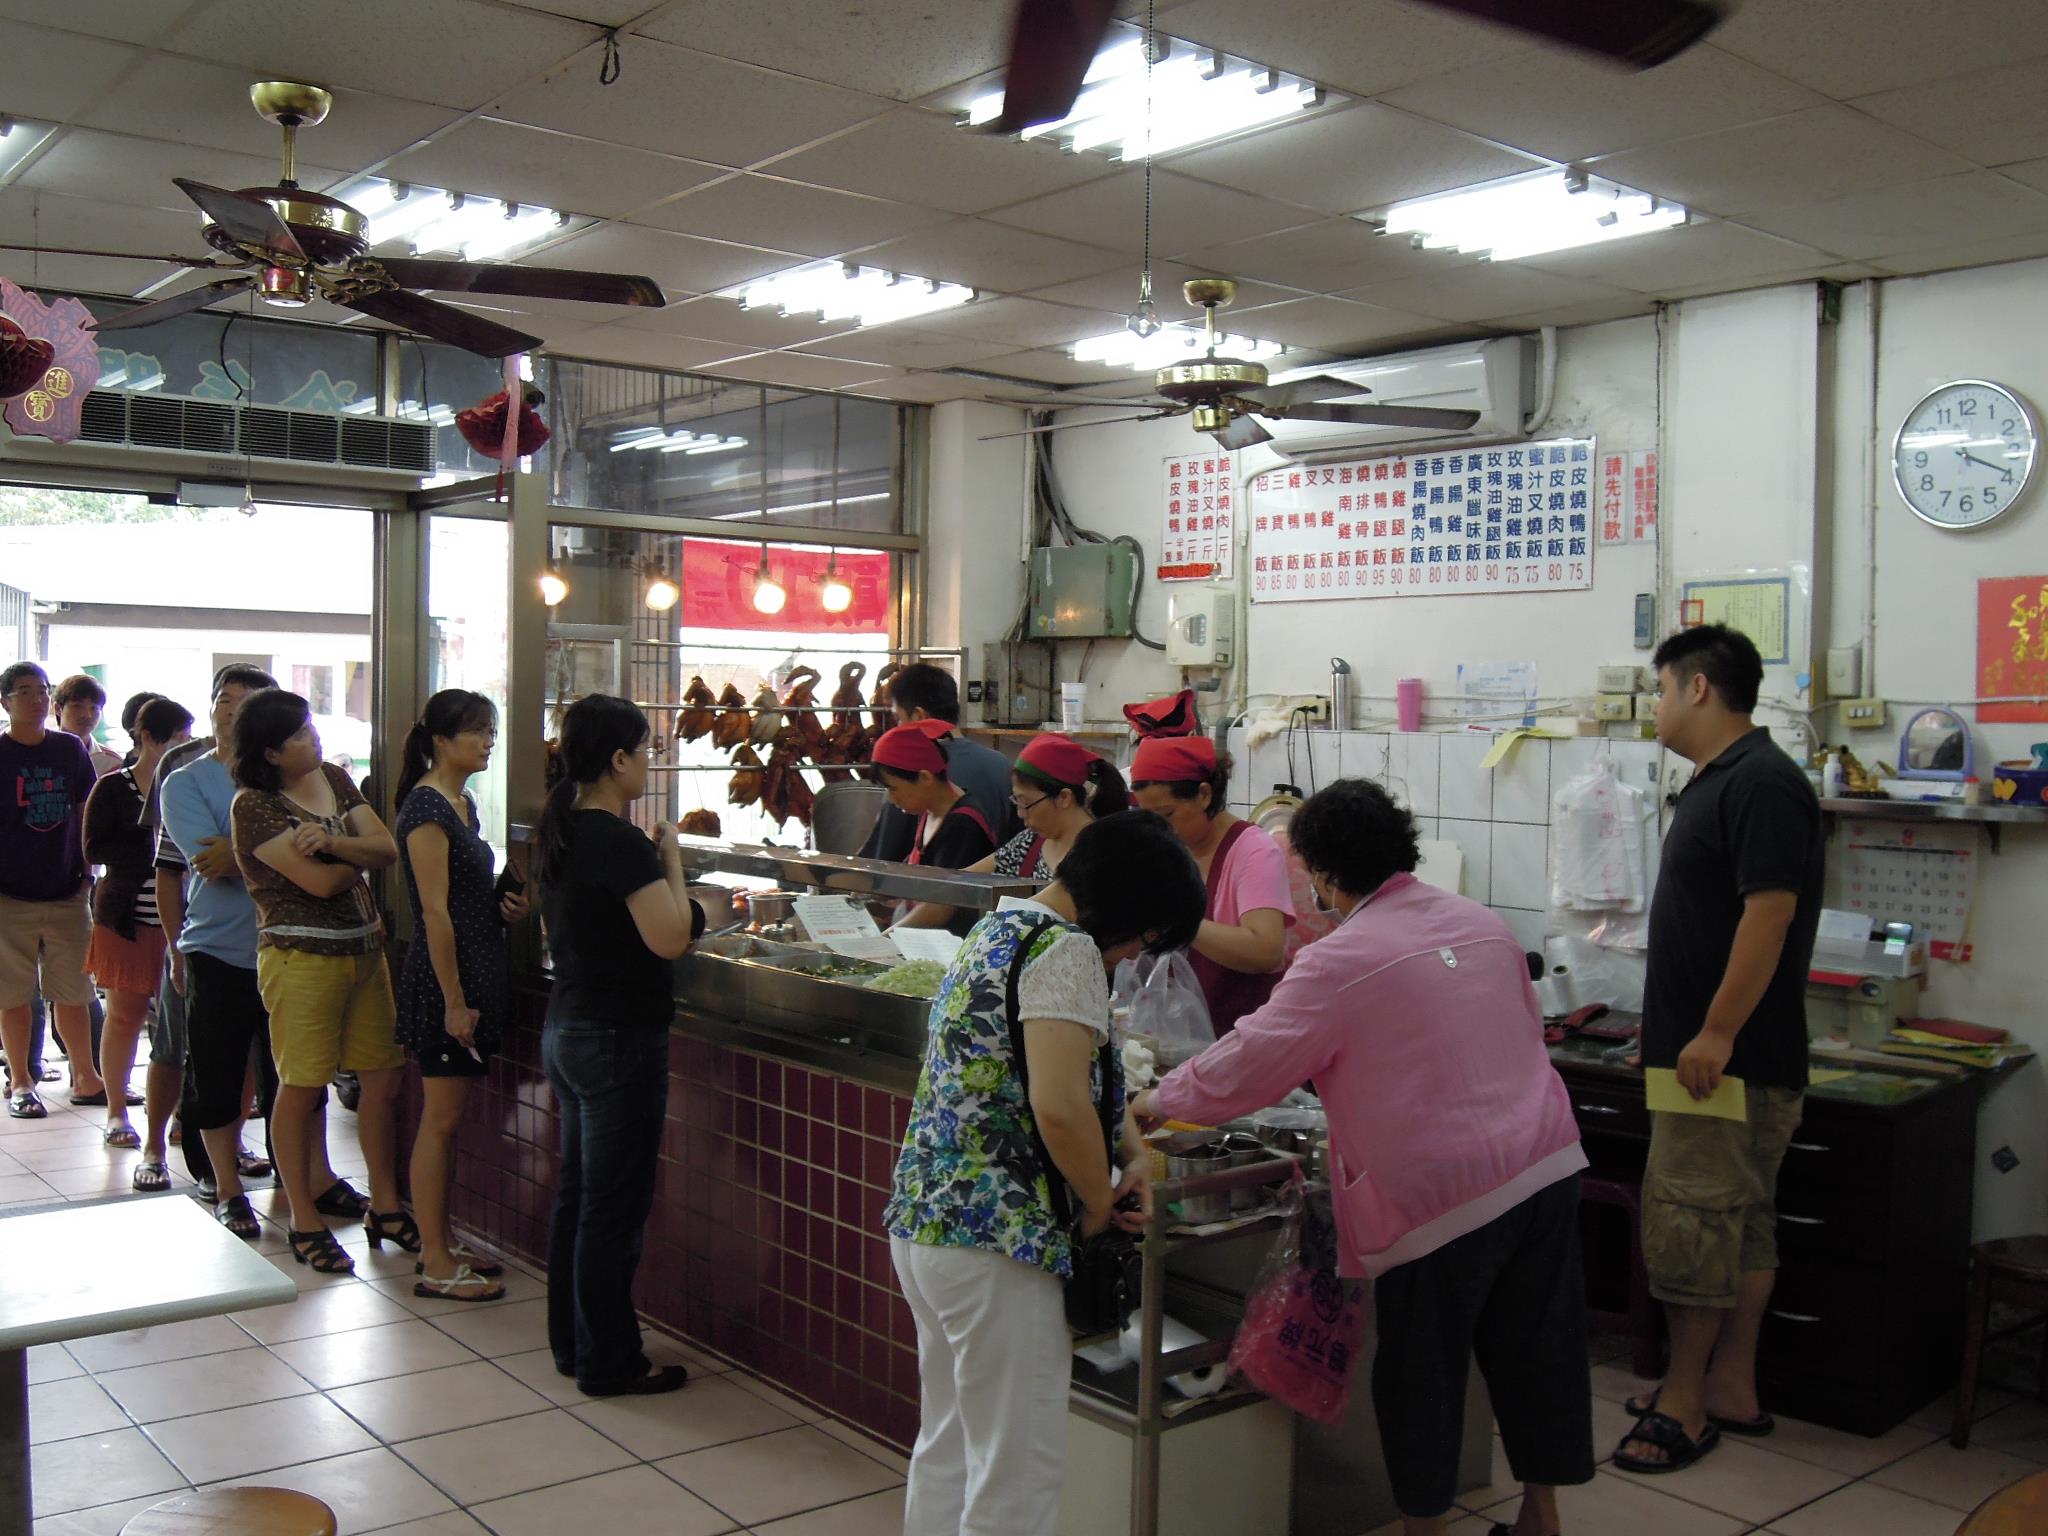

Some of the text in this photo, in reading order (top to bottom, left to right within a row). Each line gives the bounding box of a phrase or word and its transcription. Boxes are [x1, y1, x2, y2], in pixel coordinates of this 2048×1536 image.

[1958, 398, 1977, 416] 12
[1988, 404, 1995, 420] 1
[1937, 408, 1951, 425] 11
[2001, 418, 2016, 436] 2
[1914, 451, 1928, 468] 9
[1920, 474, 1934, 491] 8
[2000, 468, 2014, 485] 4
[1604, 456, 1622, 540] 請先付款
[1939, 491, 1952, 507] 7
[1959, 495, 1973, 512] 6
[1983, 487, 1997, 504] 5
[1338, 570, 1350, 586] 80
[1355, 570, 1368, 586] 90
[1373, 569, 1385, 585] 95
[1391, 568, 1403, 584] 90
[1409, 567, 1421, 584] 80
[1429, 566, 1441, 583] 80
[1447, 565, 1460, 582] 80
[1466, 564, 1479, 581] 80
[1486, 563, 1499, 581] 90
[1505, 566, 1520, 584] 75
[1525, 565, 1539, 583] 75
[1548, 563, 1562, 581] 80
[1569, 562, 1583, 580] 75
[1256, 576, 1267, 591] 90
[1271, 574, 1282, 590] 85
[1286, 574, 1297, 589] 80
[1304, 573, 1316, 589] 80
[1320, 572, 1332, 588] 80
